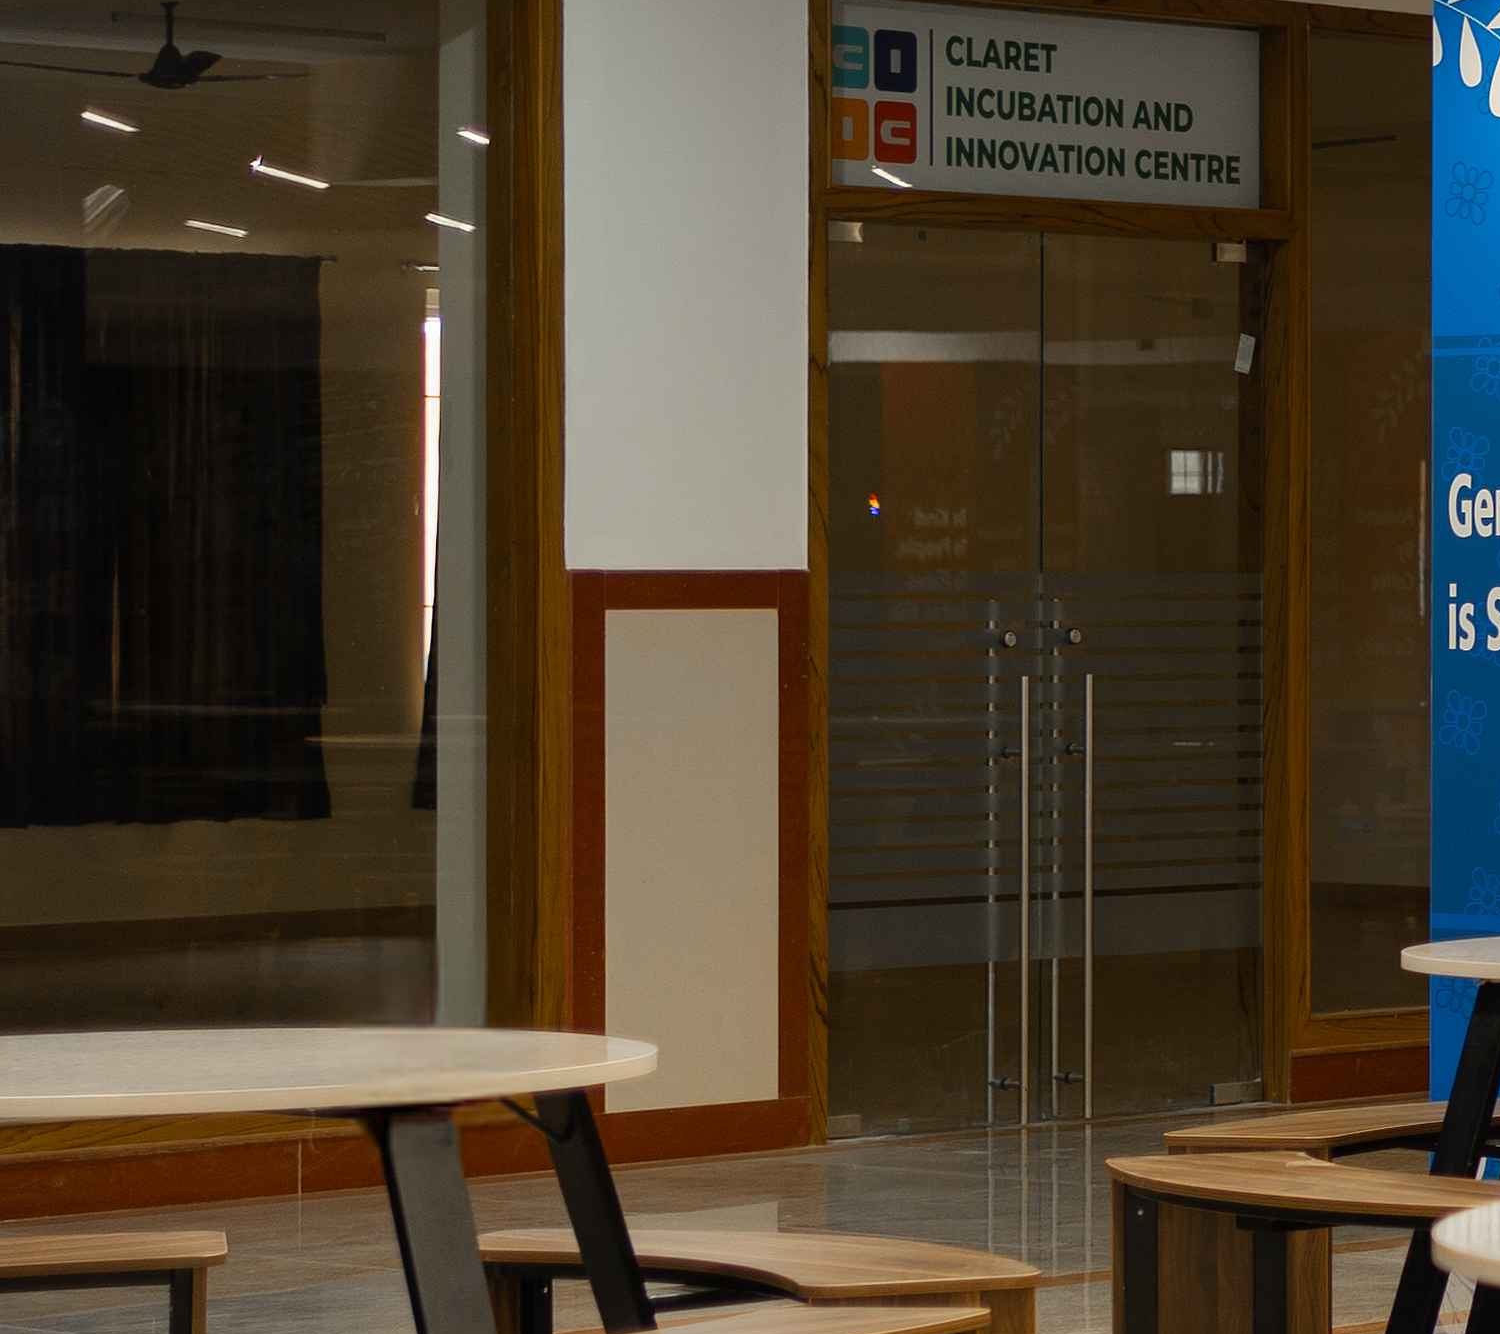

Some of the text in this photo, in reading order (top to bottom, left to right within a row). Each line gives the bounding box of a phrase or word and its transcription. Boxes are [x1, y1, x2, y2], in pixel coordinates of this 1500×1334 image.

[945, 35, 1057, 74] CLARET
[946, 86, 1193, 133] INCUBATION AND
[946, 136, 1241, 185] INNOVATION CENTRE
[1448, 582, 1476, 652] is
